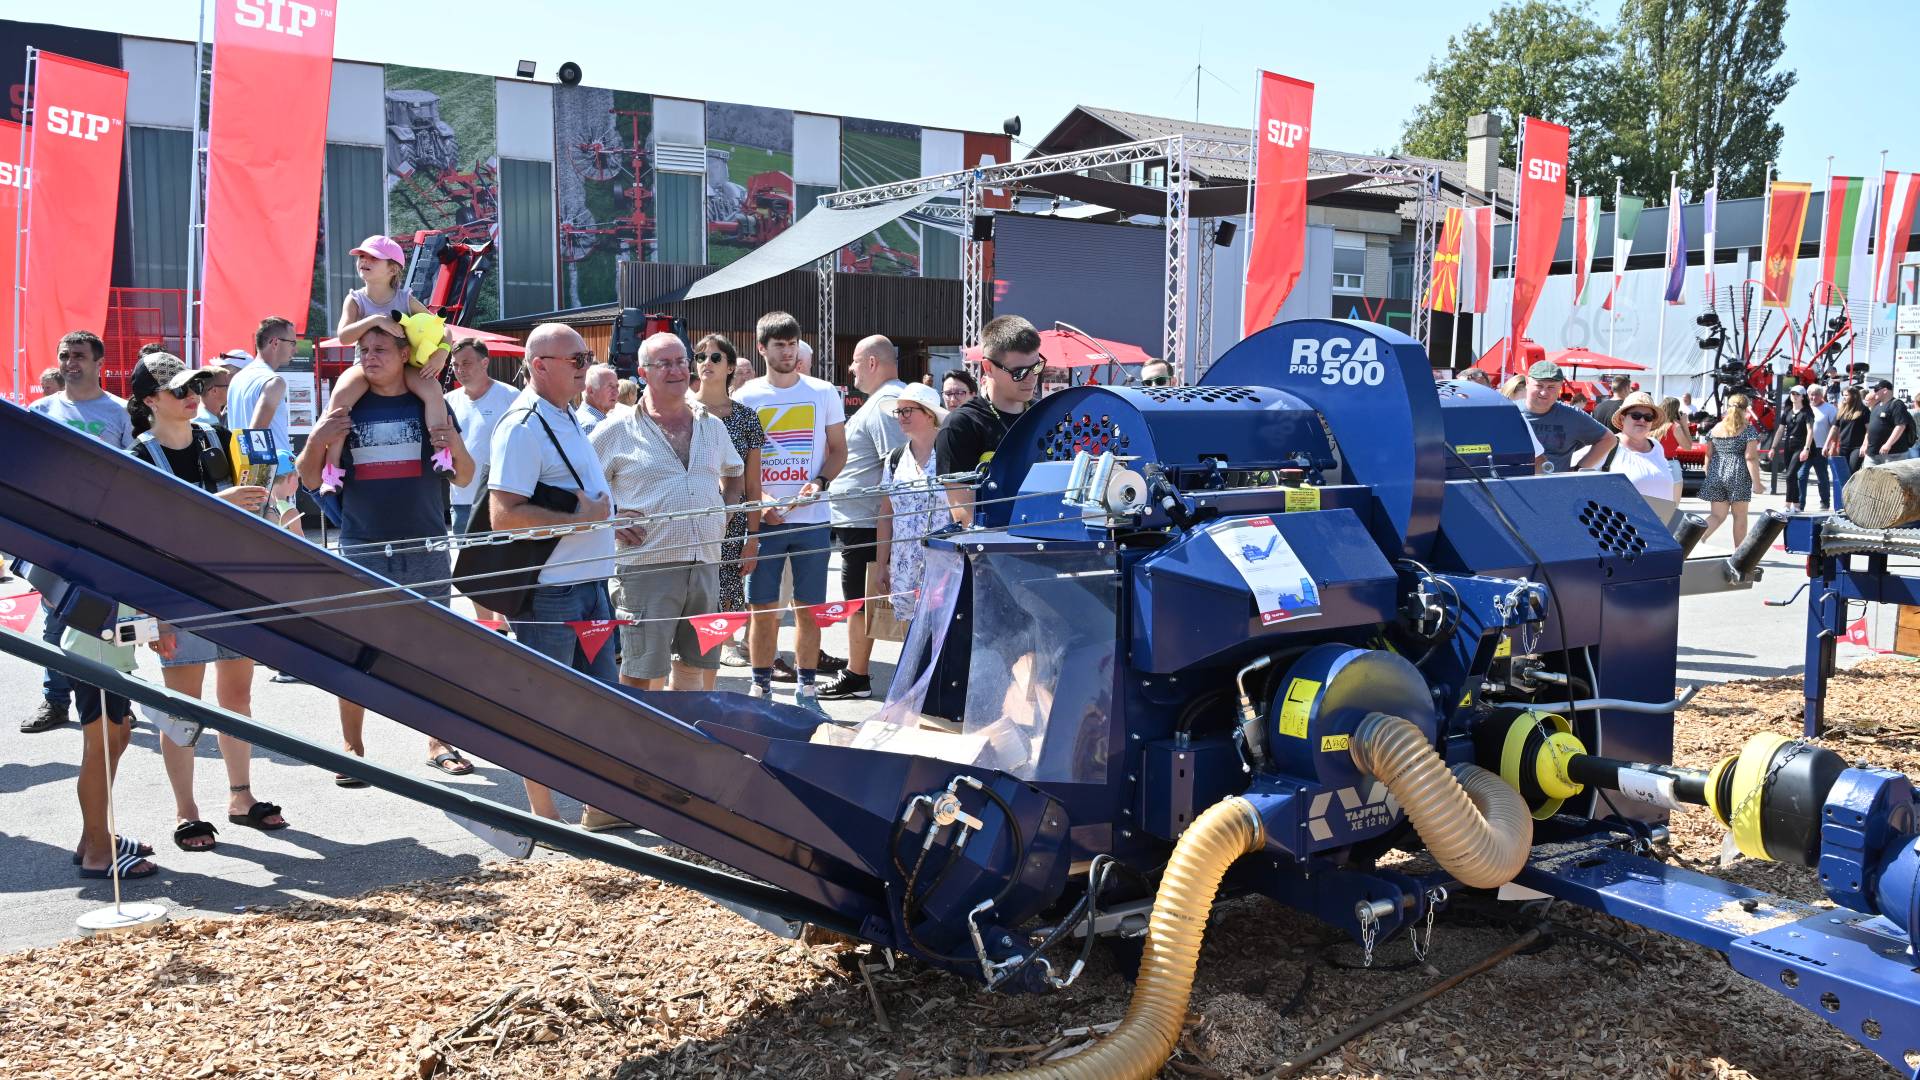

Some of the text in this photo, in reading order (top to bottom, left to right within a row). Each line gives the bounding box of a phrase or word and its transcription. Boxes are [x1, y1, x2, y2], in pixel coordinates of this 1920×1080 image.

[234, 0, 317, 37] SIP
[47, 105, 110, 141] SIP
[1267, 118, 1303, 149] SIP
[1528, 158, 1561, 183] SIP
[1290, 337, 1378, 365] RCA
[1289, 360, 1385, 386] PRO 500
[761, 457, 810, 467] PRODUCTS BY
[761, 466, 809, 482] Kodak
[1345, 804, 1387, 821] TAJFUN
[1351, 814, 1390, 831] XE 12 Hy
